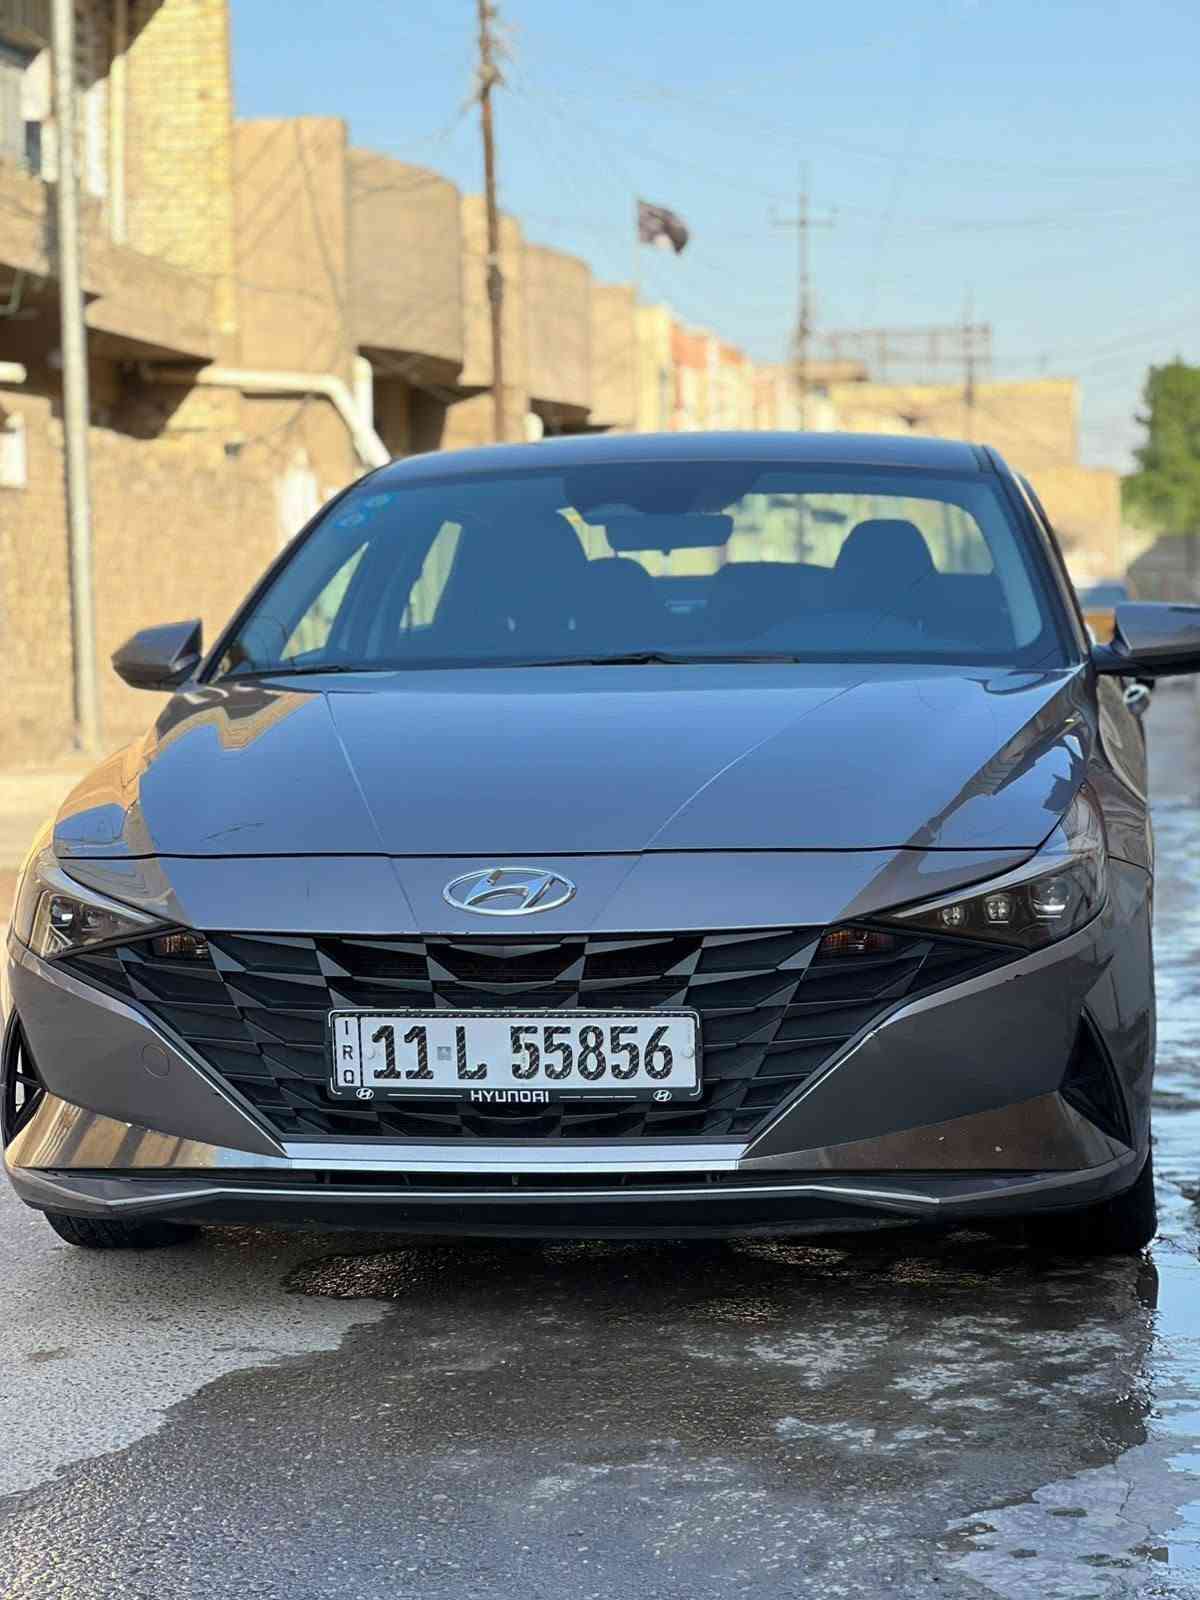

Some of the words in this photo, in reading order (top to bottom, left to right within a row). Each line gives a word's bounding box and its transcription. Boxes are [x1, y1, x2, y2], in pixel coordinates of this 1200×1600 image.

[343, 1020, 354, 1085] IRQ
[371, 1025, 434, 1080] 11
[456, 1025, 488, 1080] L
[510, 1025, 674, 1081] 55856
[470, 1090, 550, 1103] HYUNDAI
